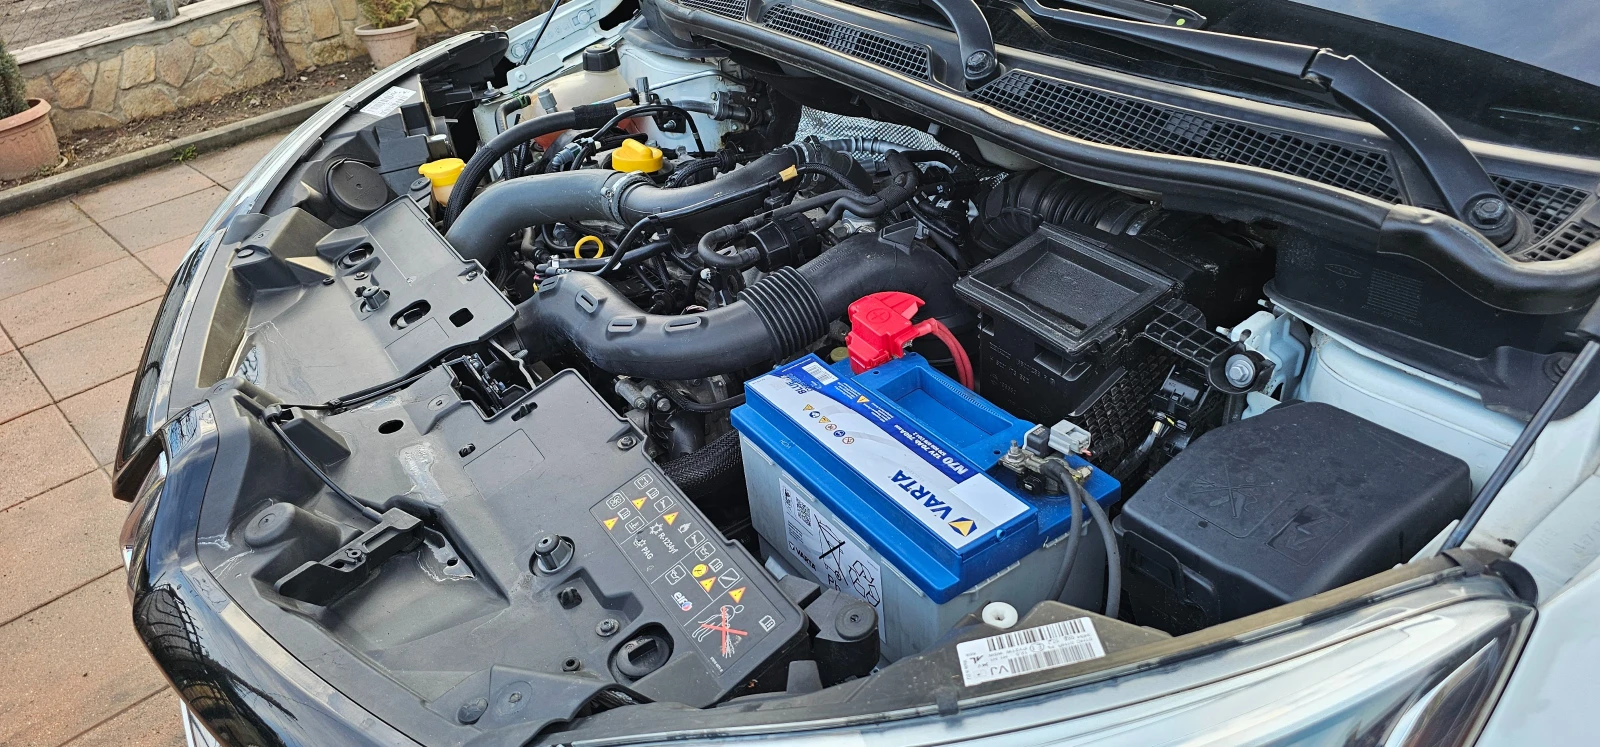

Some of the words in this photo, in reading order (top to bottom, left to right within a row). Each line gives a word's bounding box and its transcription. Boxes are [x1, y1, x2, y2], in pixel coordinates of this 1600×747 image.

[942, 456, 969, 475] N70
[890, 469, 953, 520] VARTA
[641, 546, 654, 560] PAG
[795, 546, 817, 571] VARTA
[990, 665, 1009, 676] VJ
